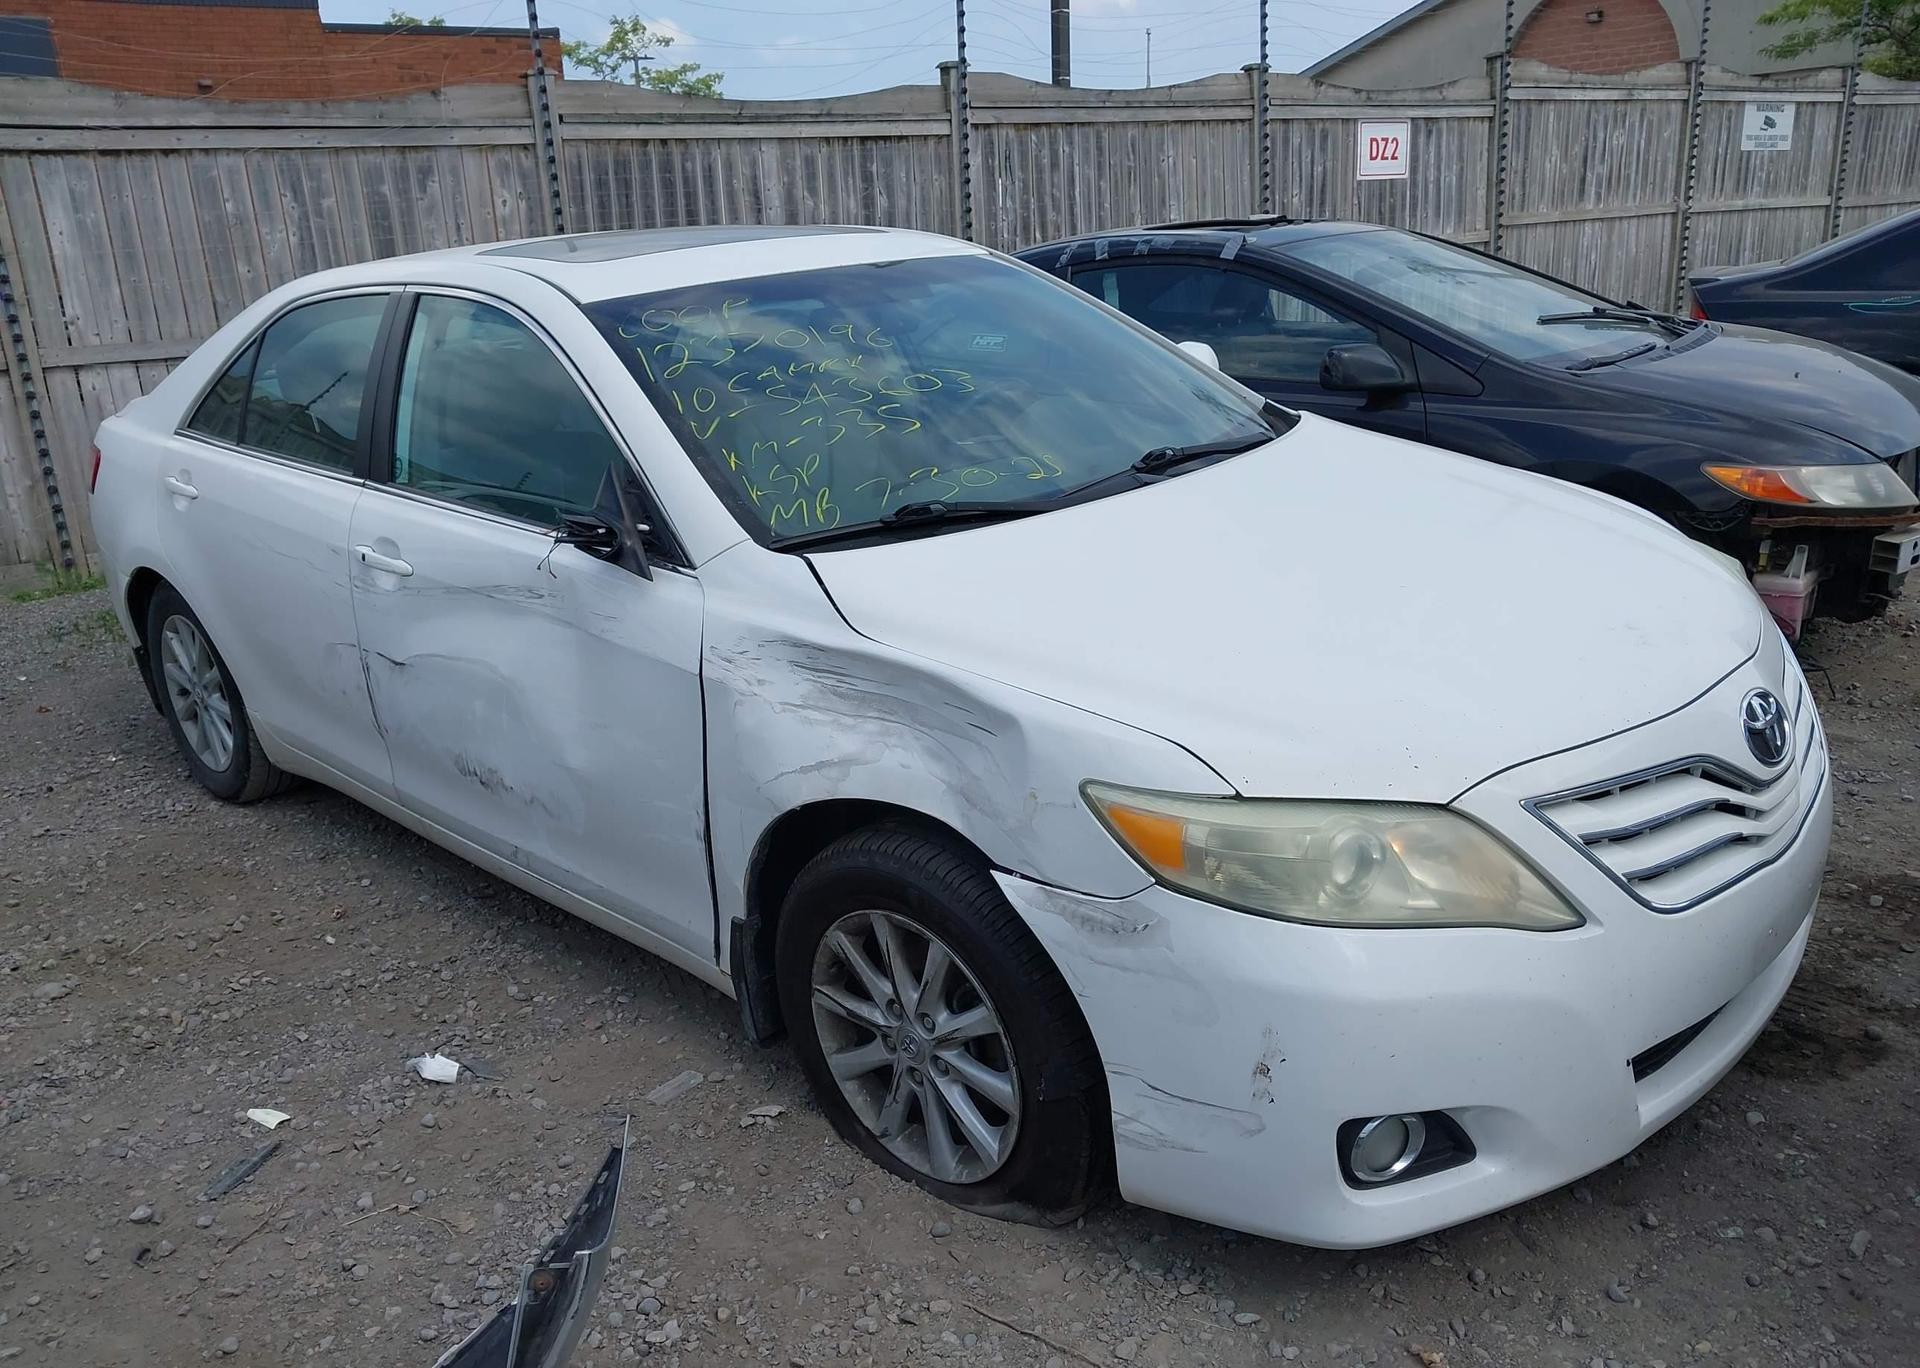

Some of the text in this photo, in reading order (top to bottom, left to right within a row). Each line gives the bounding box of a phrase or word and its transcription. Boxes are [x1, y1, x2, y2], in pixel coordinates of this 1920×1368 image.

[1369, 136, 1399, 161] DZ2
[671, 386, 716, 415] 10
[770, 486, 841, 537] MB
